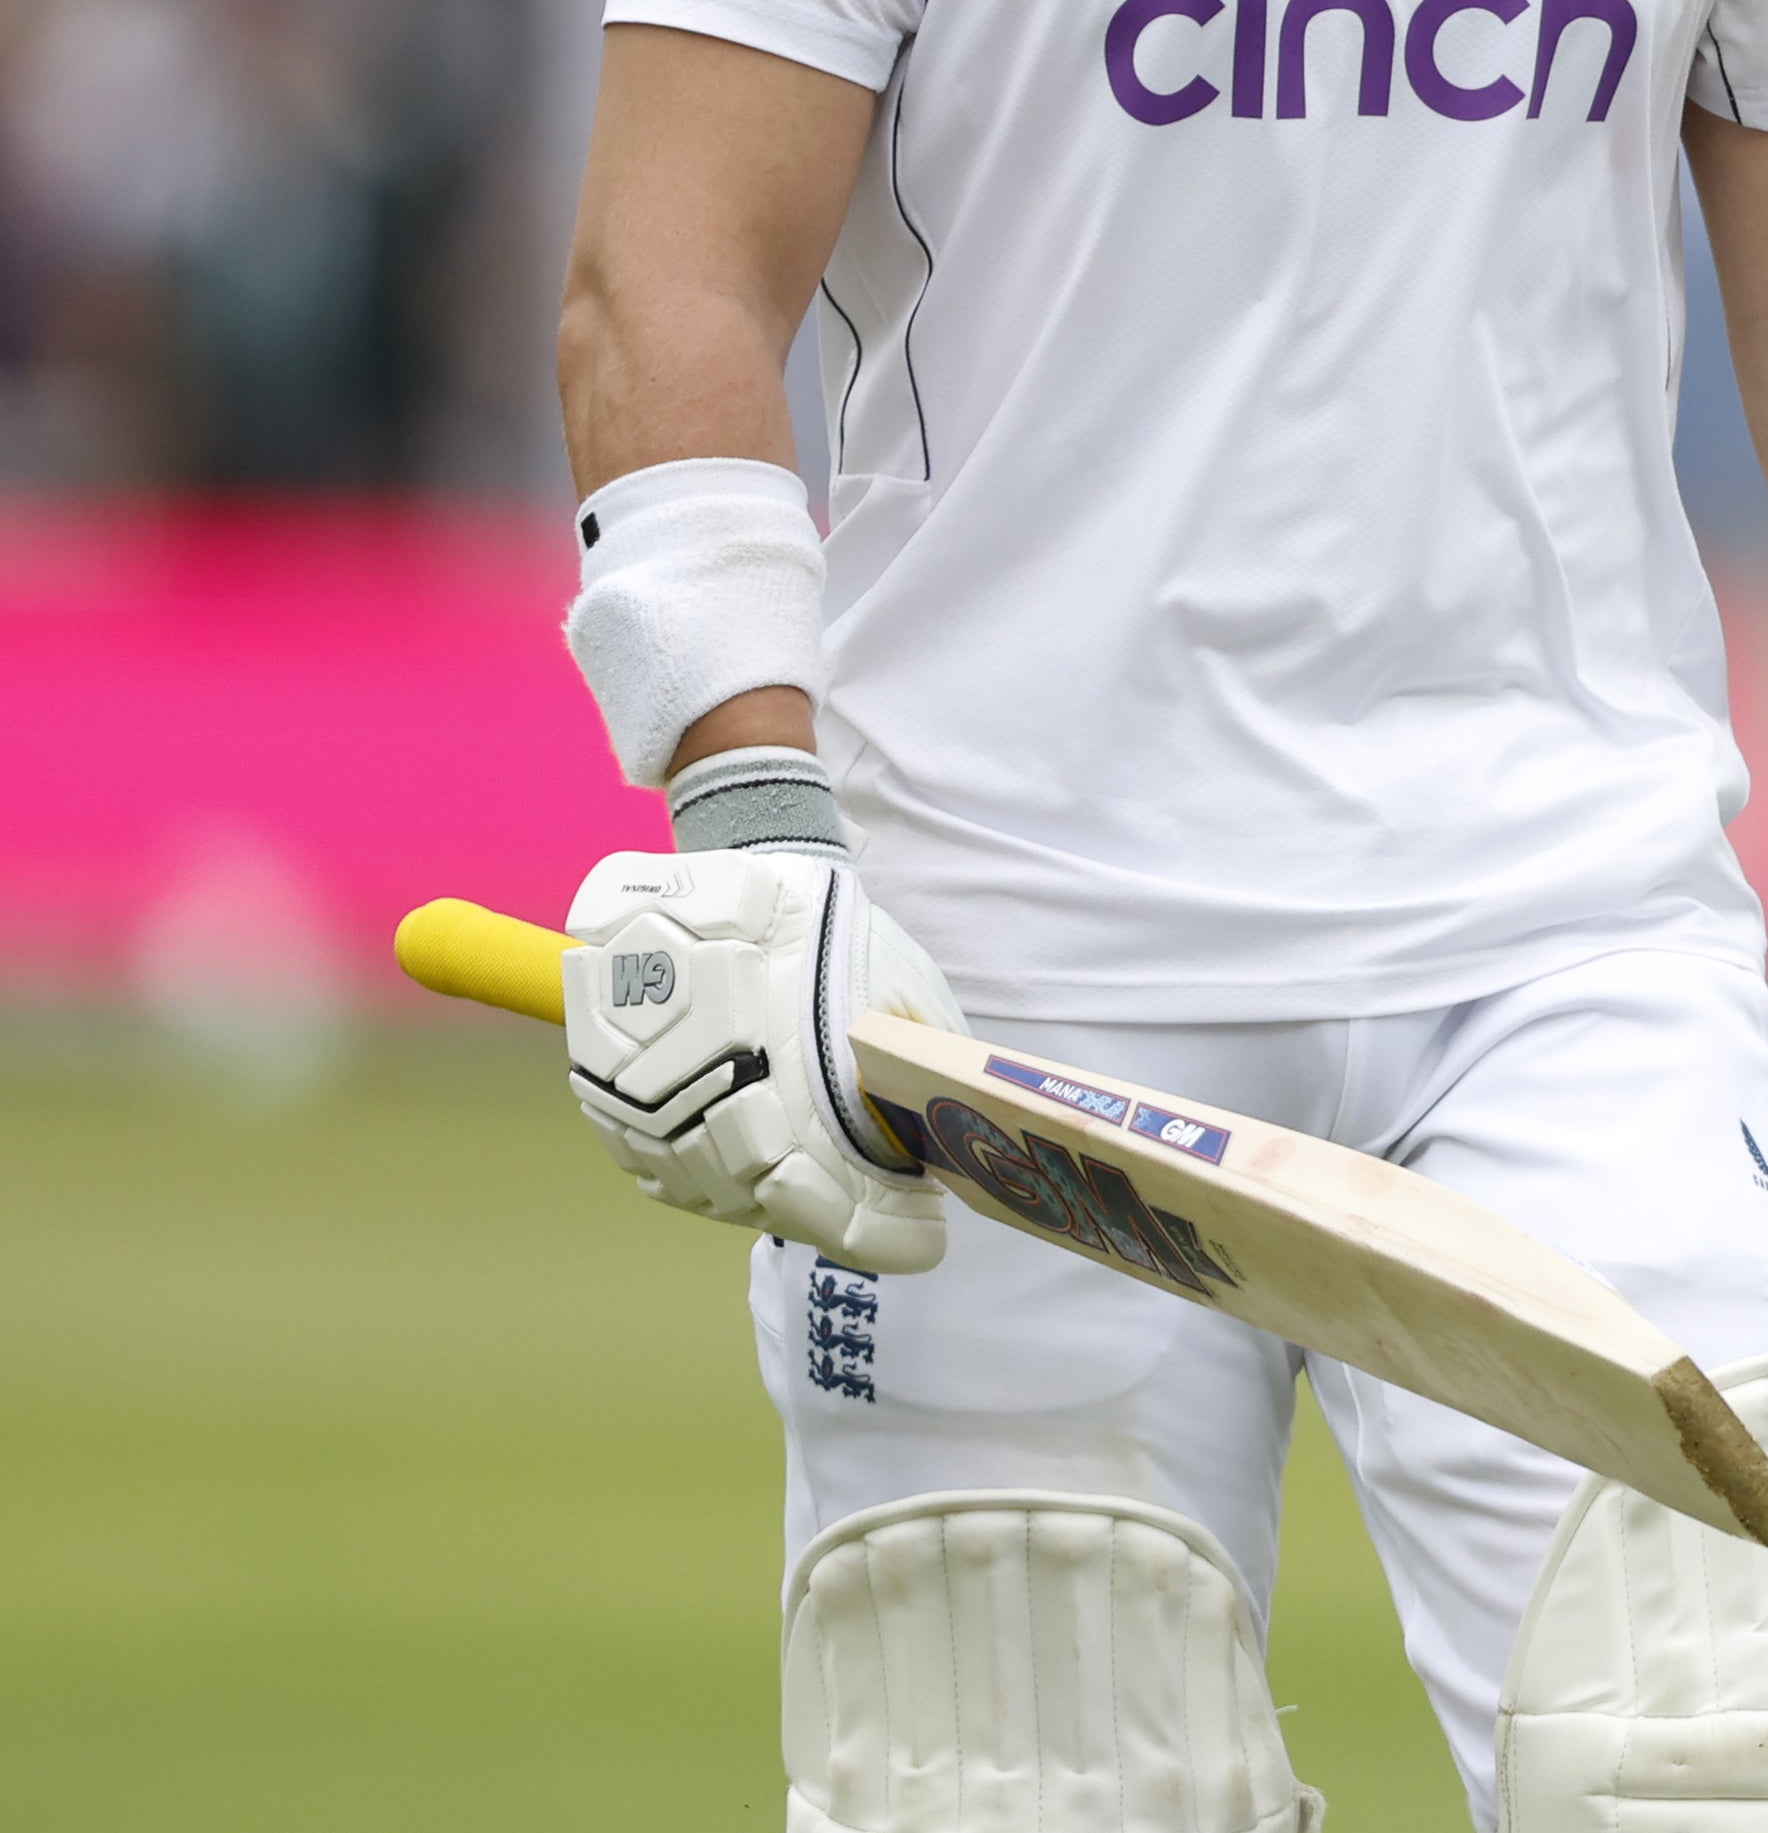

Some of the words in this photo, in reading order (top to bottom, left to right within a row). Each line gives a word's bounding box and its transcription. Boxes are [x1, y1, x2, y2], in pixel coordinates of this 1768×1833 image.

[612, 950, 676, 1007] GM
[1039, 1076, 1083, 1102] MANA
[1160, 1118, 1206, 1148] GM
[926, 1096, 1213, 1298] GM
